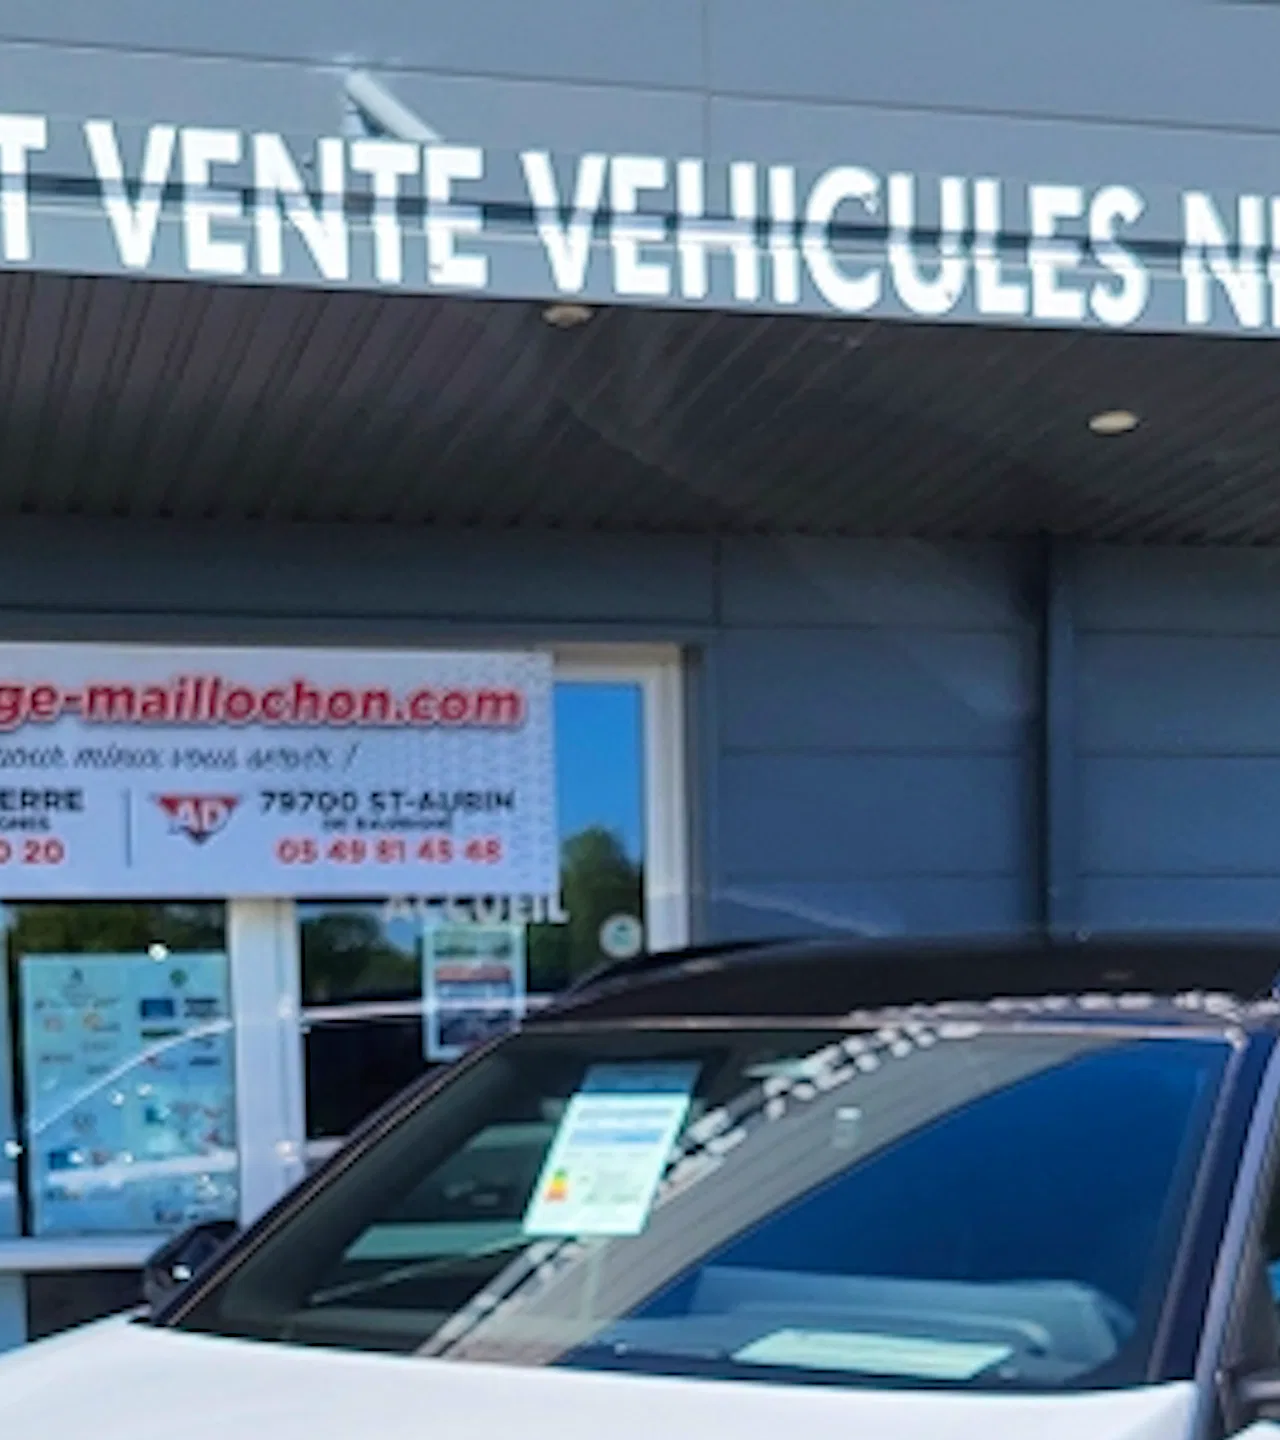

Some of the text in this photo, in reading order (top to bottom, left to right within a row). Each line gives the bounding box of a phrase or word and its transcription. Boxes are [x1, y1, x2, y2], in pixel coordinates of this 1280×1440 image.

[83, 119, 489, 289] VENTE
[519, 150, 1152, 328] VEHICULES
[259, 788, 360, 816] 79700
[21, 839, 67, 865] 20
[276, 837, 320, 865] 05
